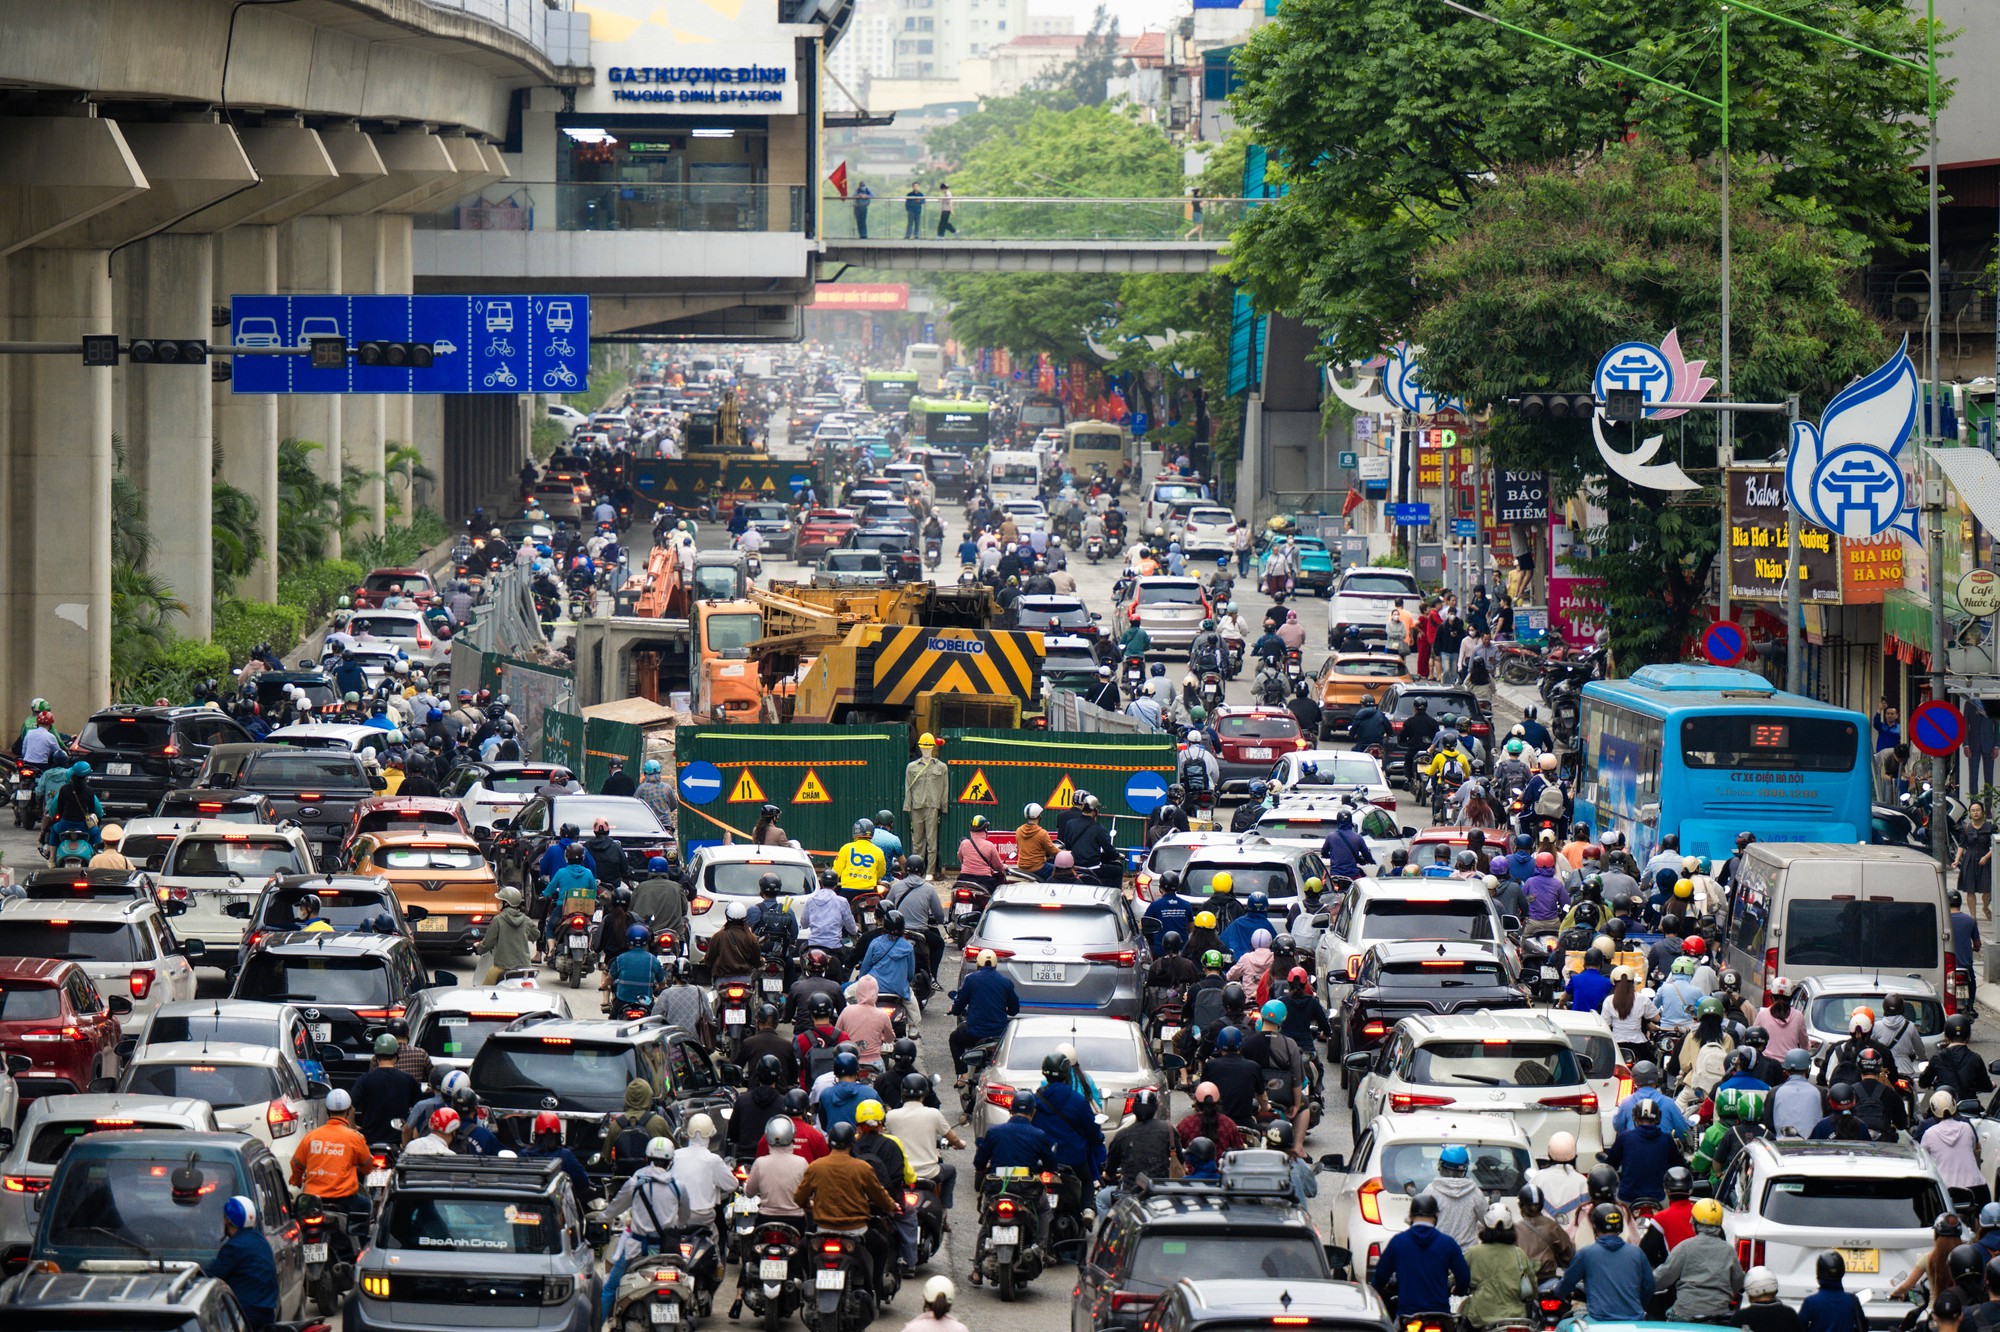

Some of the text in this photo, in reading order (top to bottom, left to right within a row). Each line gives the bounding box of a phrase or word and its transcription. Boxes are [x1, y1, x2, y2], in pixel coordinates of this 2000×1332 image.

[608, 67, 636, 82] GA
[612, 90, 675, 102] THUONG
[720, 90, 782, 102] STATION
[1419, 429, 1457, 449] LED
[1507, 485, 1542, 501] BẢO
[1745, 474, 1781, 507] Balon
[1502, 502, 1547, 520] HIỂM
[1732, 527, 1749, 548] Bia
[1850, 549, 1878, 564] BIA
[1755, 558, 1782, 585] Nhậu
[1853, 564, 1877, 582] HÀ
[1971, 585, 1994, 596] Café
[1963, 597, 1987, 607] Nước
[928, 638, 984, 654] KOBELCO
[1755, 726, 1783, 746] 27
[1730, 773, 1743, 783] CT
[1743, 773, 1754, 783] XE
[850, 848, 875, 868] be
[1036, 973, 1062, 981] 128.18
[323, 1147, 345, 1157] Food
